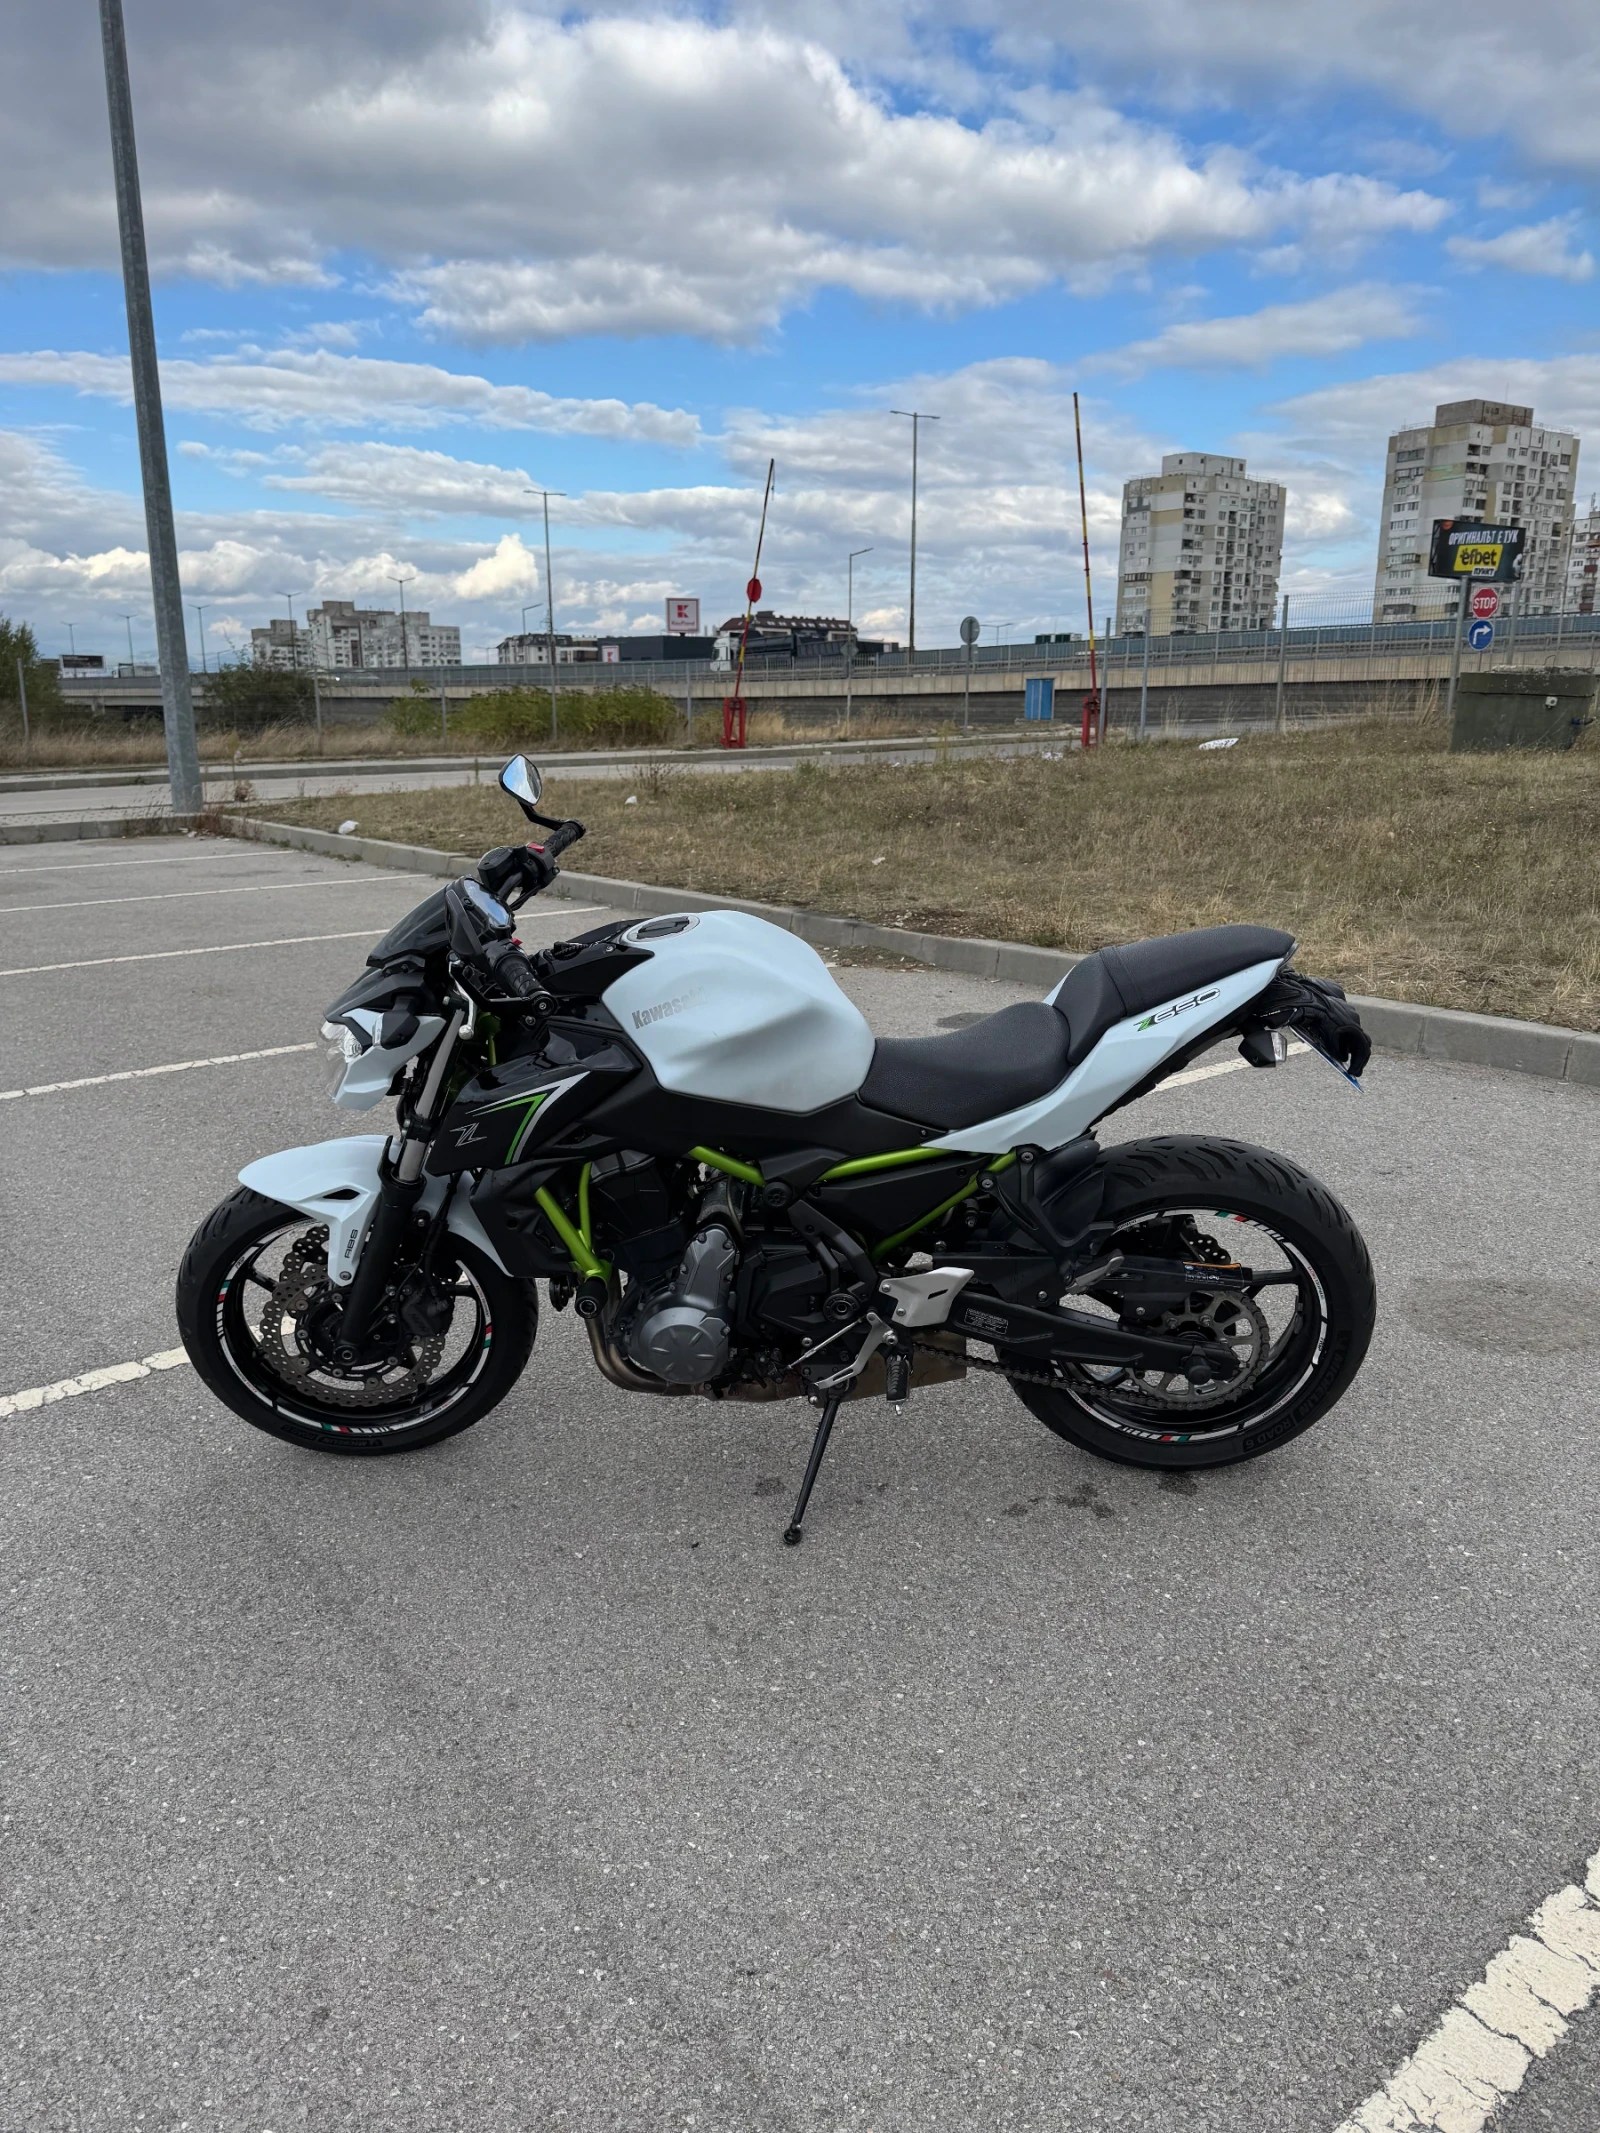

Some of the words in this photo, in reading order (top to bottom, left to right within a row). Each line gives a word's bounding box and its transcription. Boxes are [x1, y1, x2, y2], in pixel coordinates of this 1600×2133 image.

[1448, 531, 1495, 545] ОРИГИНАЛЪТ
[1503, 530, 1519, 544] ТУК
[1460, 547, 1497, 566] efbet
[1473, 597, 1497, 610] STOP
[631, 986, 708, 1030] Kawasaki
[344, 1229, 359, 1259] ABS
[1299, 1350, 1344, 1417] MICHELIN
[1257, 1418, 1292, 1444] ROAD
